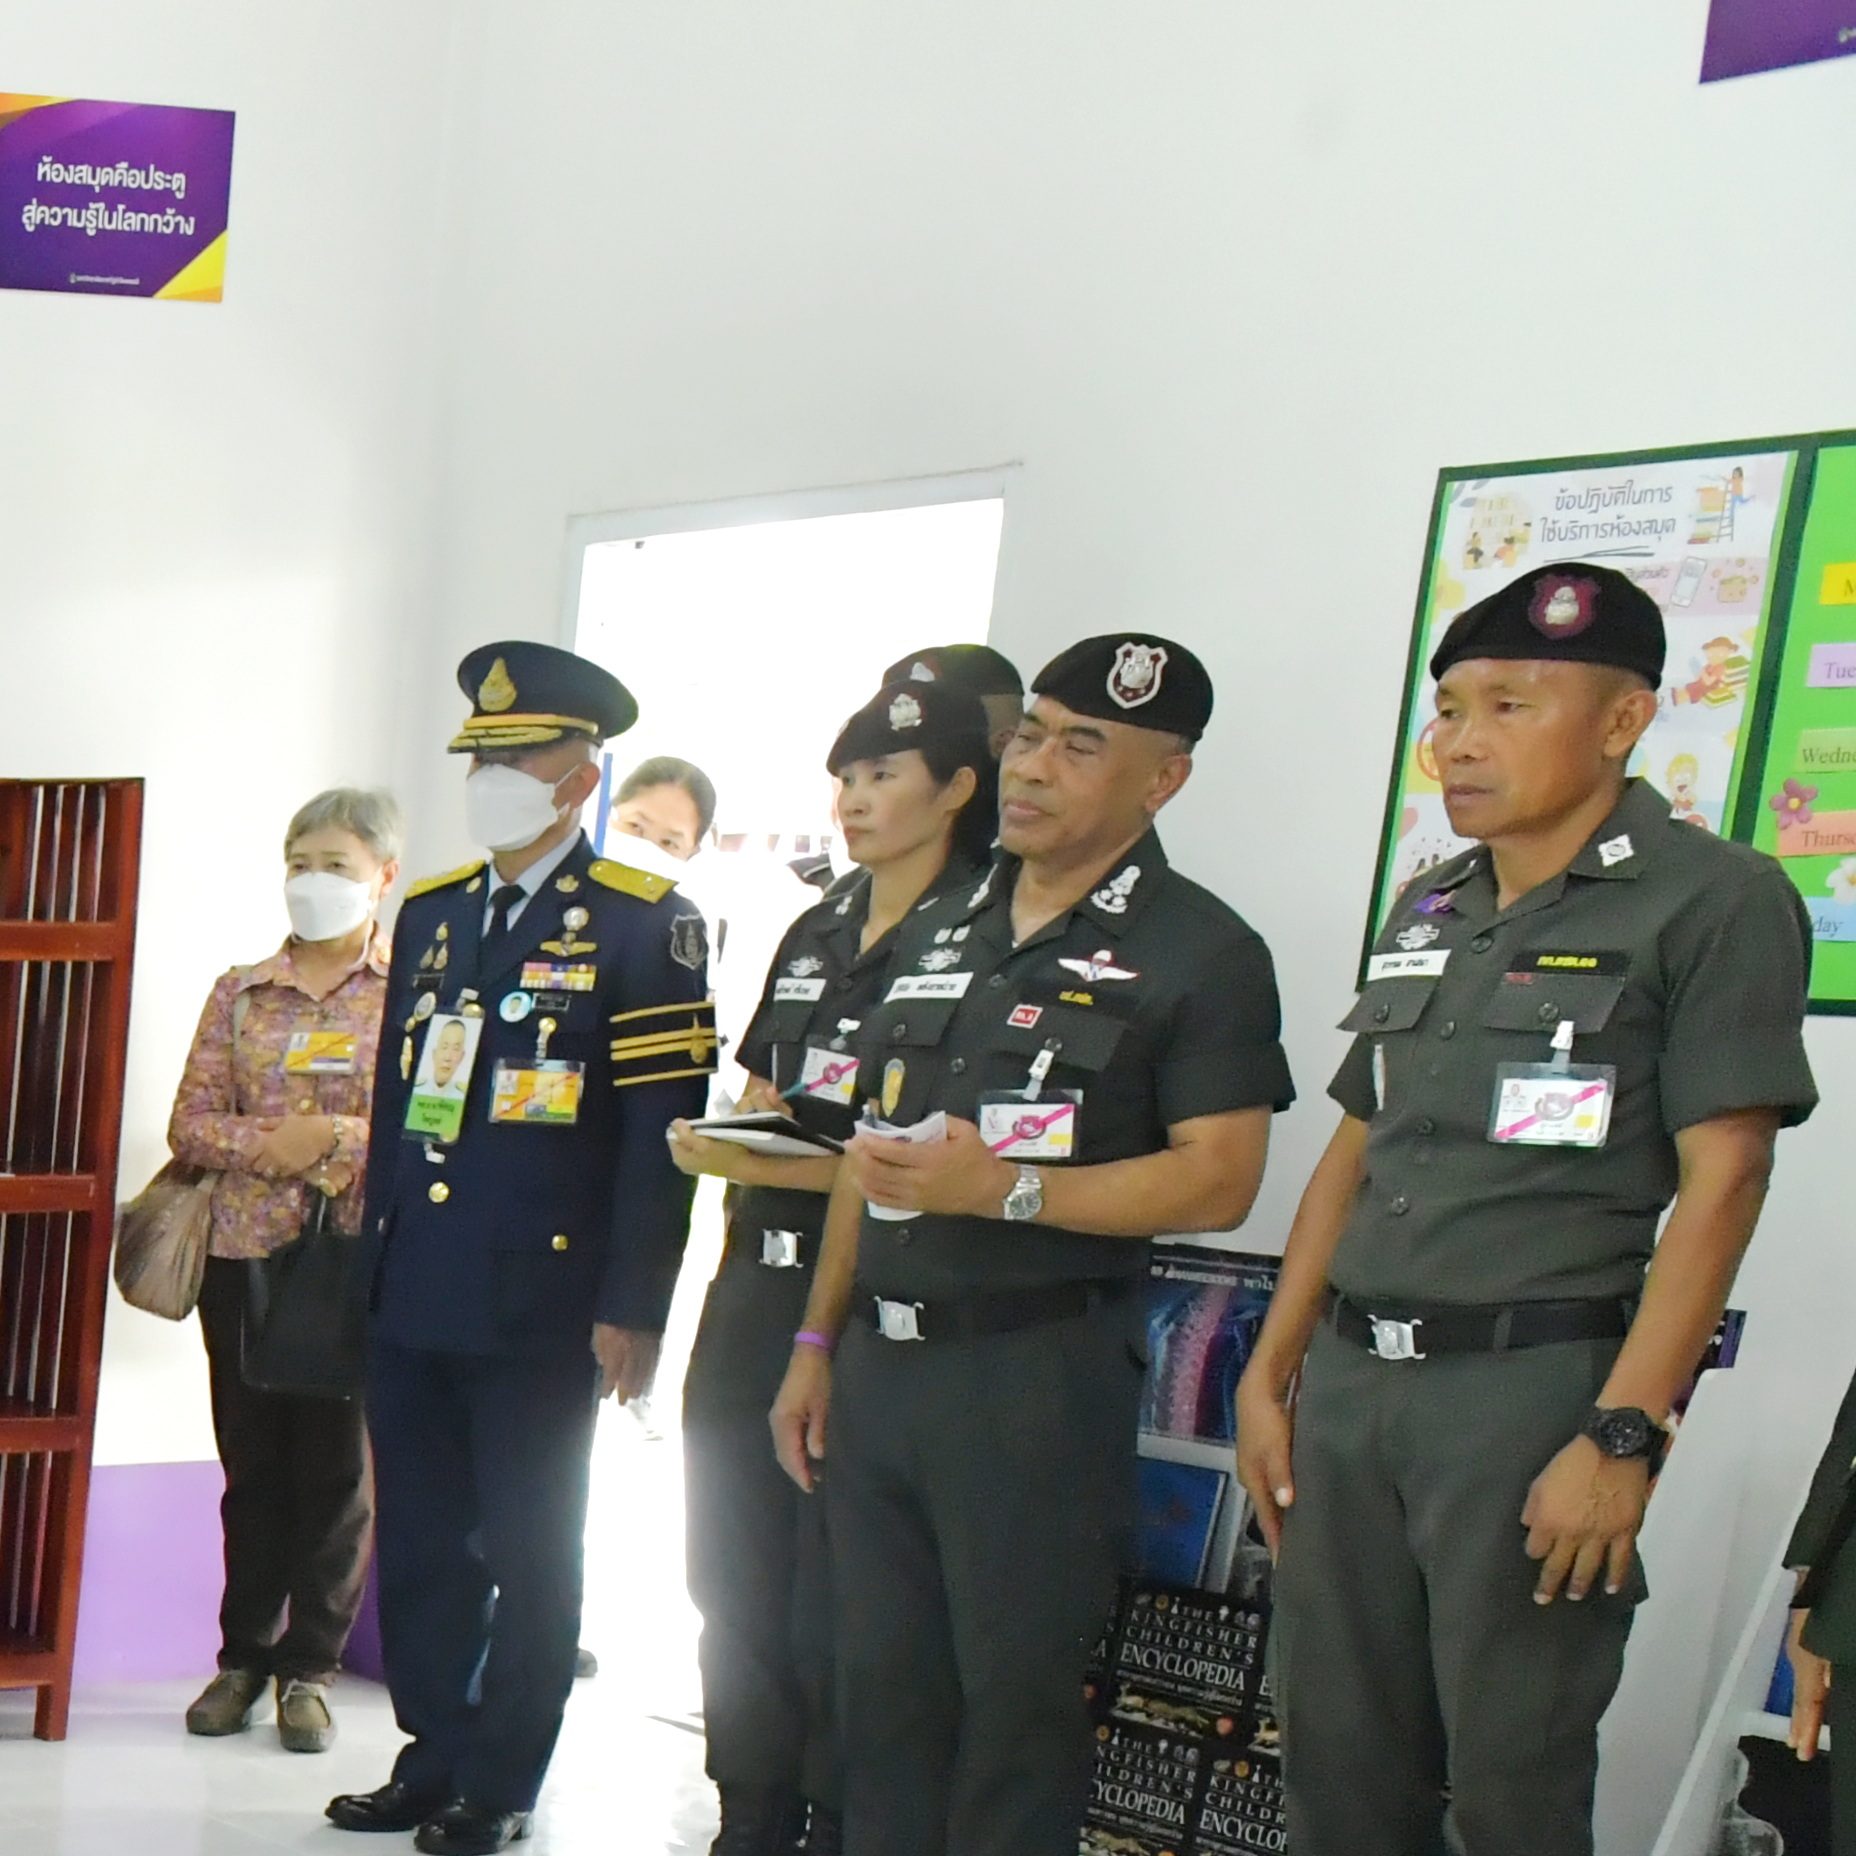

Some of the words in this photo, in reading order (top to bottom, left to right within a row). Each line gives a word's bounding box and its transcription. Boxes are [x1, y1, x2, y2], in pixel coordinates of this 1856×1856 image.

[37, 155, 186, 199] ห้องสมุดคือประตู
[22, 198, 195, 236] สู่ความรู้ในโลกกว้าง
[1555, 479, 1674, 514] ข้อปฏิบัติในการ
[1540, 515, 1676, 543] ใช้บริการห้องสมุด
[1126, 1626, 1254, 1665] CHILDREN'S
[1130, 1609, 1258, 1649] KINGFISHER
[1120, 1641, 1246, 1691] ENCYCLOPEDIA
